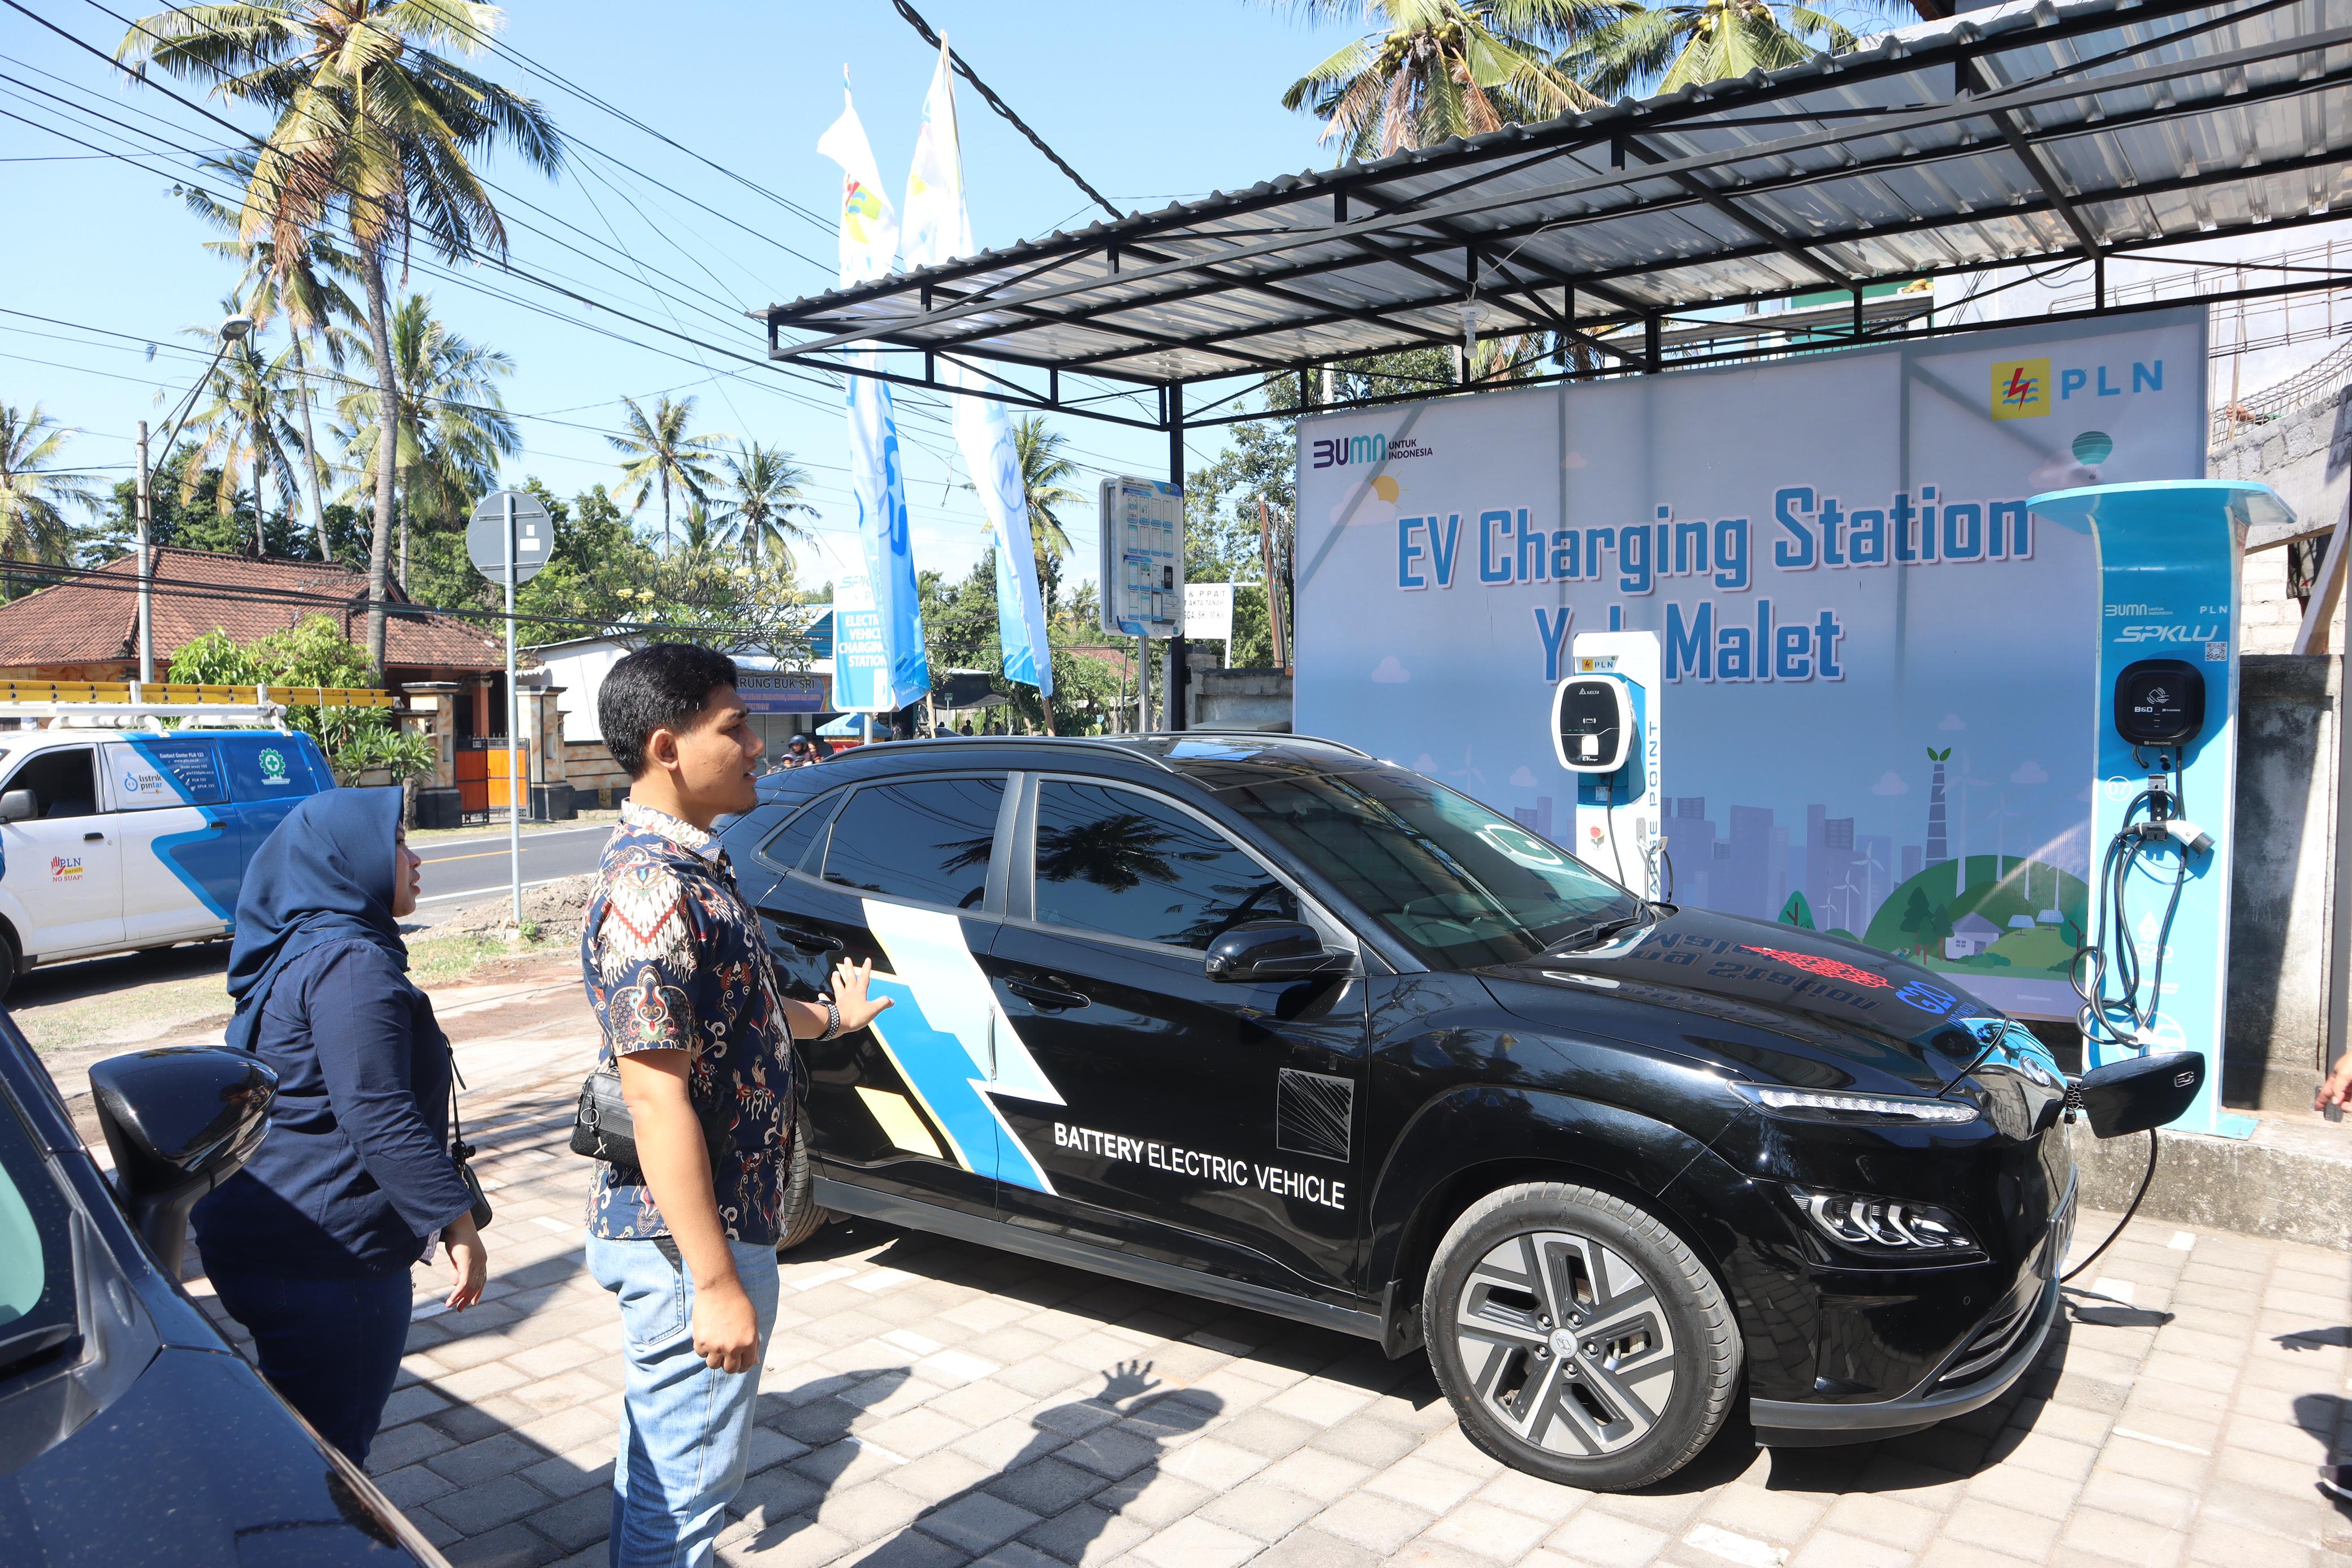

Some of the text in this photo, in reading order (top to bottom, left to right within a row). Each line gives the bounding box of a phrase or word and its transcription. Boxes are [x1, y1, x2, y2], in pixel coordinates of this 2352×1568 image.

[2061, 359, 2163, 400] PLN
[1389, 439, 1417, 449] UNTUK
[1313, 434, 1386, 469] BUMN
[1389, 447, 1433, 461] INDONESIA
[1397, 486, 2030, 594] EV Charging Station
[838, 575, 871, 589] SPK
[2105, 604, 2147, 616] BUMN
[2200, 605, 2228, 614] PLN
[845, 614, 880, 627] ELECTR
[849, 627, 882, 640] VEHICL
[1664, 598, 1841, 682] Malet
[2113, 625, 2218, 642] SPKLU
[838, 641, 884, 654] CHARGIN
[775, 678, 796, 689] BUK
[799, 679, 814, 690] SRI
[1649, 721, 1658, 807] POINT
[141, 782, 162, 791] pintar
[2108, 782, 2129, 796] 07
[59, 857, 81, 868] PLN
[1895, 981, 1957, 1015] G20
[1054, 1122, 1345, 1210] BATTERY ELECTRIC VEHICLE
